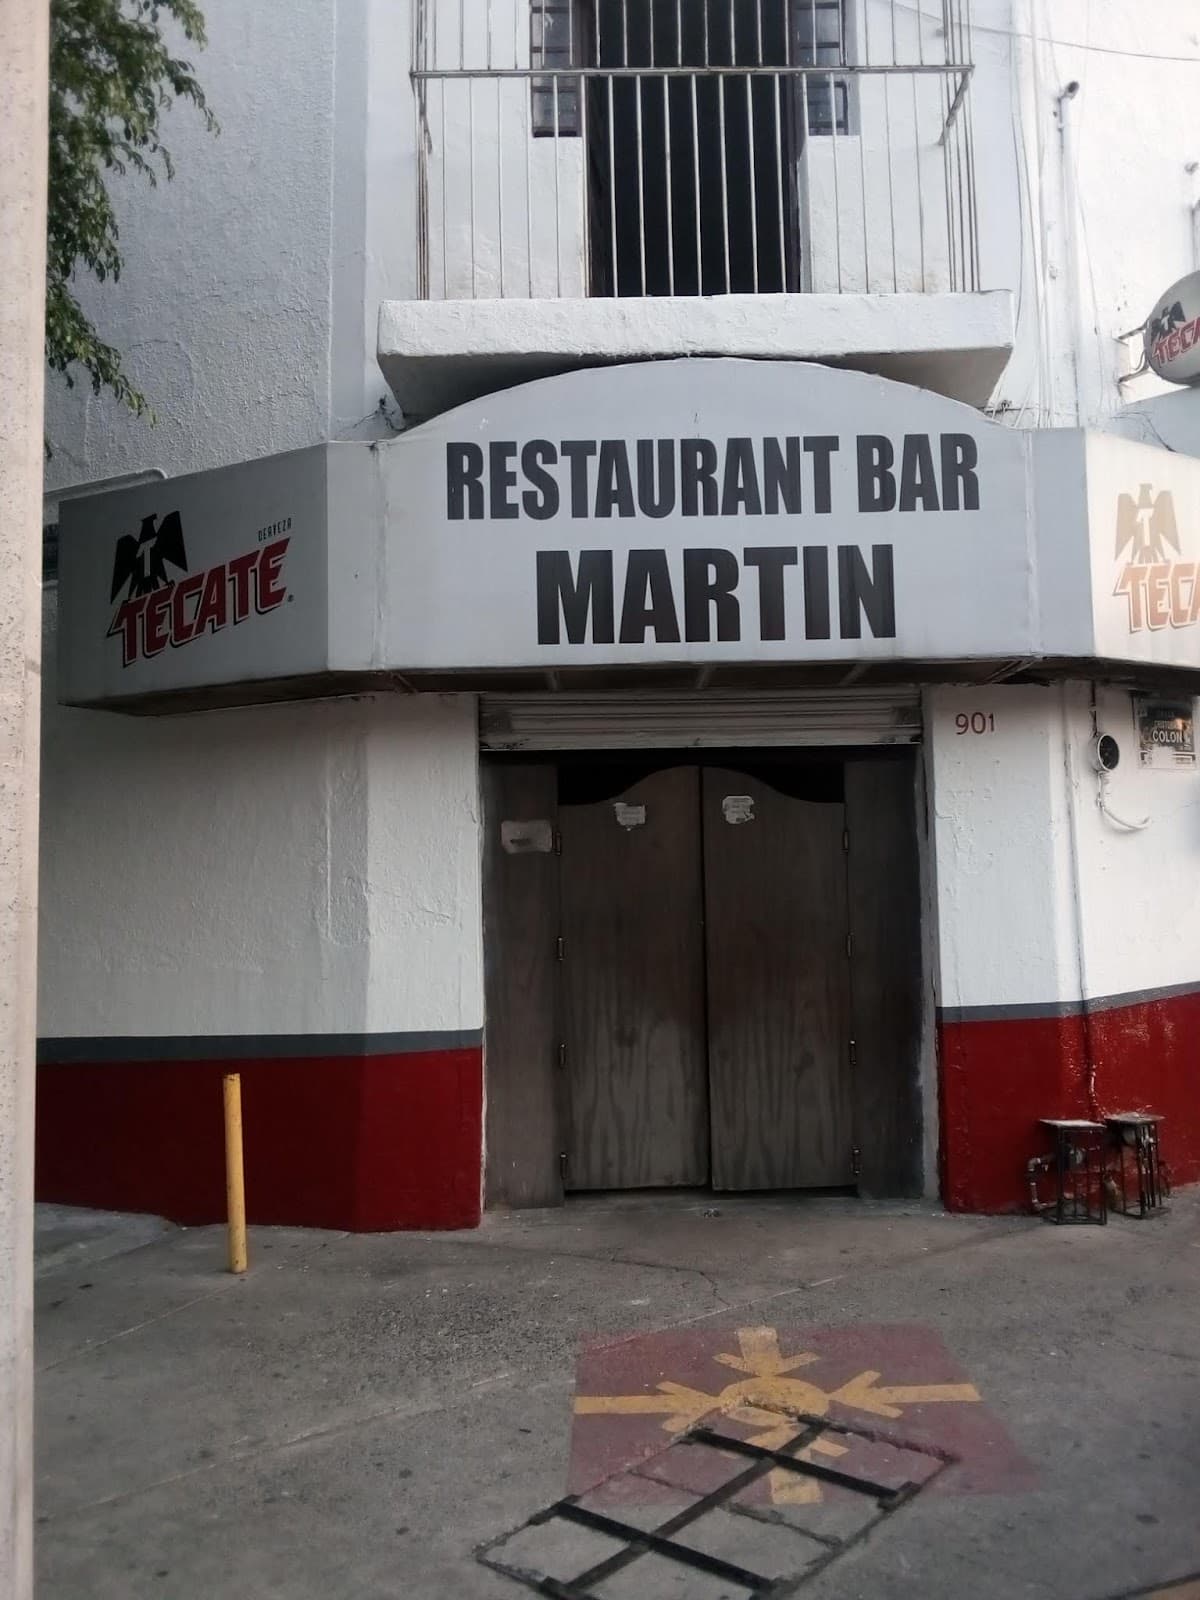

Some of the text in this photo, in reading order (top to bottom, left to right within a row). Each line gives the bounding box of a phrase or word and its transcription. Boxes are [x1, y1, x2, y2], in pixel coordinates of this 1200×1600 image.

[446, 433, 981, 520] RESTAURANT BAR
[107, 537, 291, 668] TECATE
[536, 543, 897, 645] MARTIN
[955, 711, 994, 735] 901
